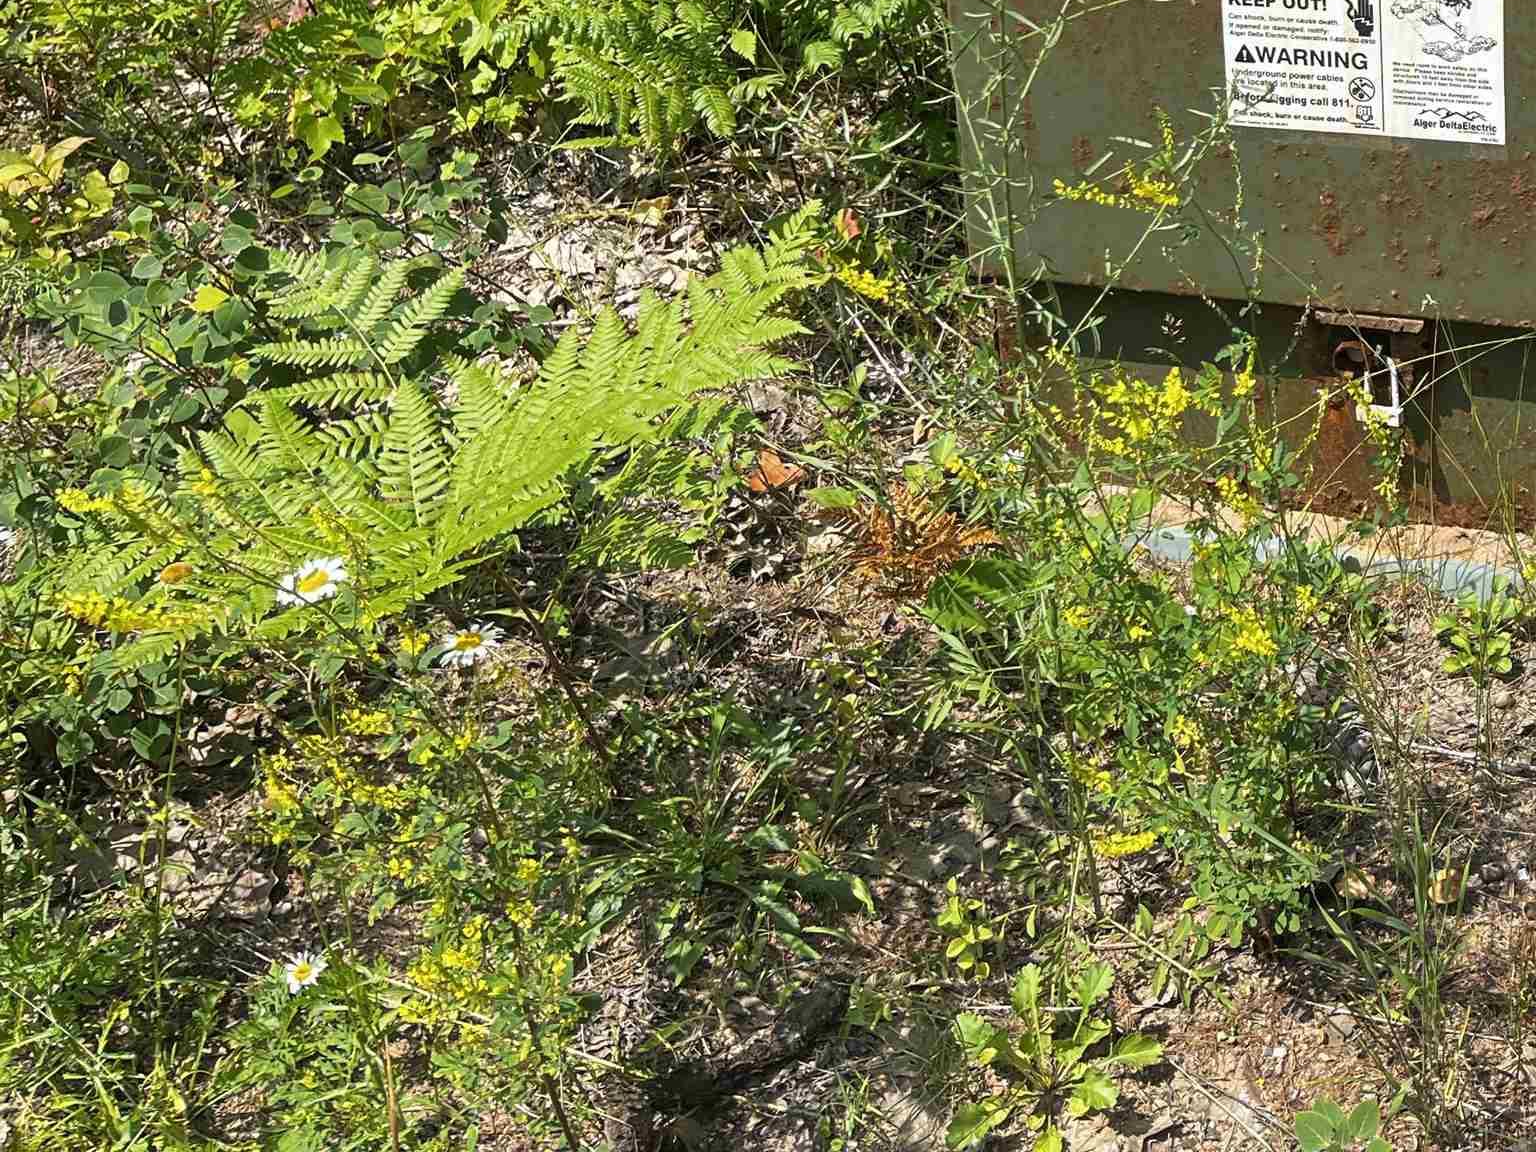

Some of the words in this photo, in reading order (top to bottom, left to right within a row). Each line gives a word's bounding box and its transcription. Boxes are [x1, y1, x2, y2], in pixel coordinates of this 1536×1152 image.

[1255, 46, 1368, 70] WARNING
[1289, 72, 1314, 82] power
[1316, 74, 1344, 82] cables
[1280, 80, 1288, 88] in
[1290, 81, 1306, 89] this
[1270, 94, 1307, 106] igging
[1310, 97, 1329, 106] call
[1414, 118, 1437, 129] Alger
